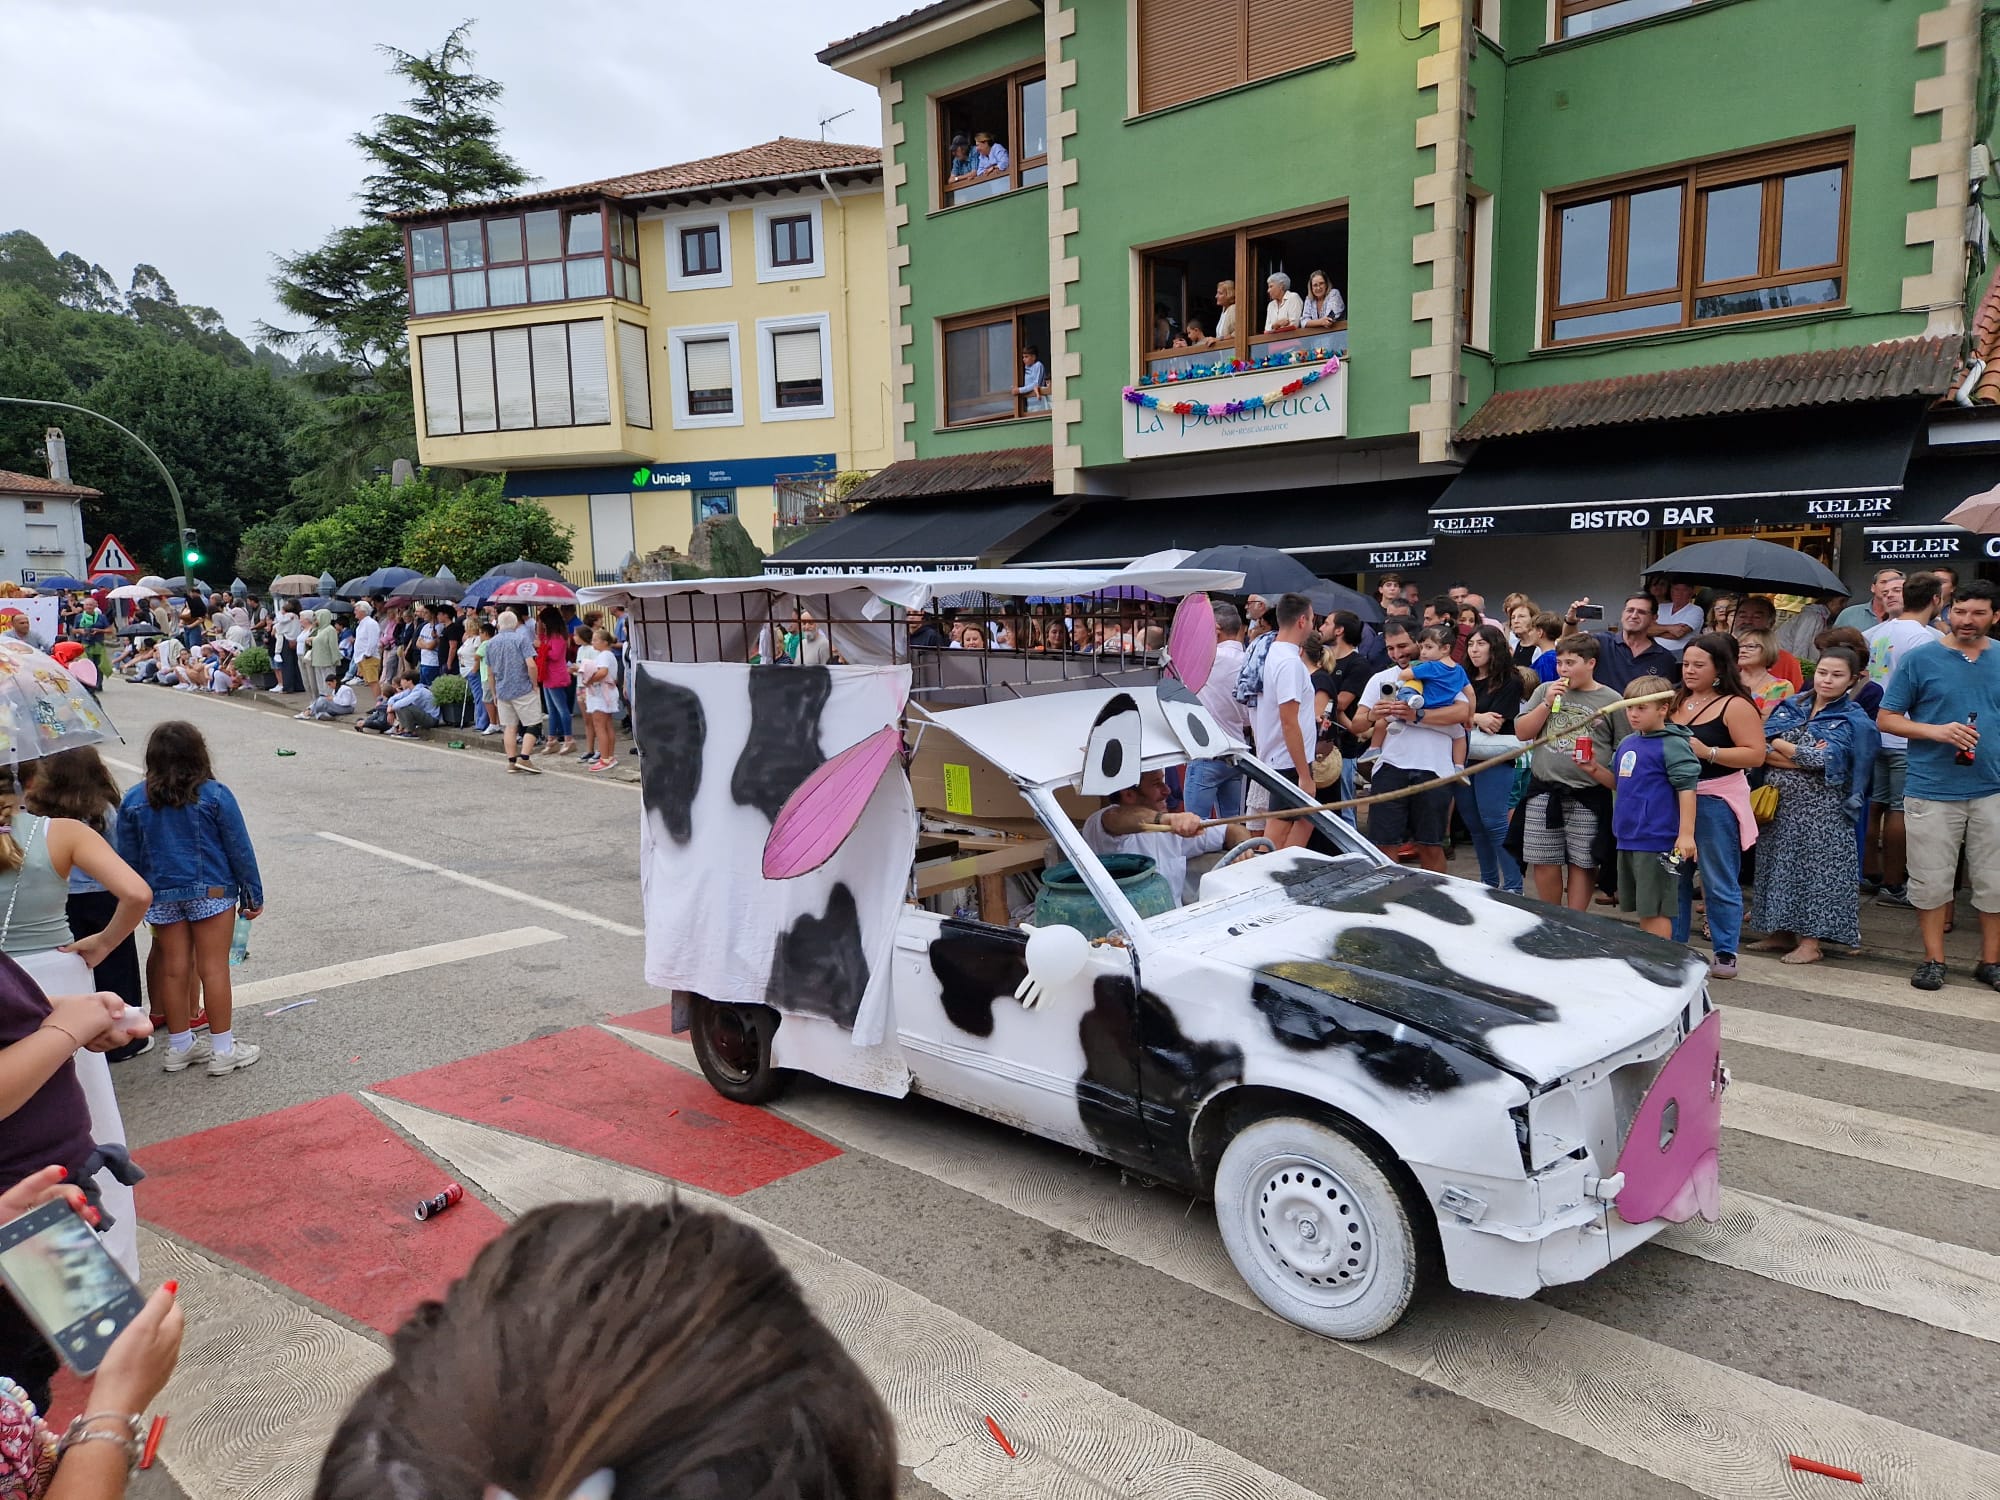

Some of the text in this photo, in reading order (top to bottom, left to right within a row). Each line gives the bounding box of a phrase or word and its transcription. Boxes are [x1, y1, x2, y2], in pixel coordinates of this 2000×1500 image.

[1136, 403, 1164, 434] La
[651, 472, 691, 486] Unicaja
[1807, 498, 1892, 513] KELER
[1433, 516, 1494, 529] KELER
[1570, 507, 1714, 529] BISTRO BAR
[1871, 538, 1960, 552] KELER
[1369, 550, 1426, 563] KELER
[763, 567, 795, 576] KELER
[806, 565, 923, 575] COCINA DE MERCADO
